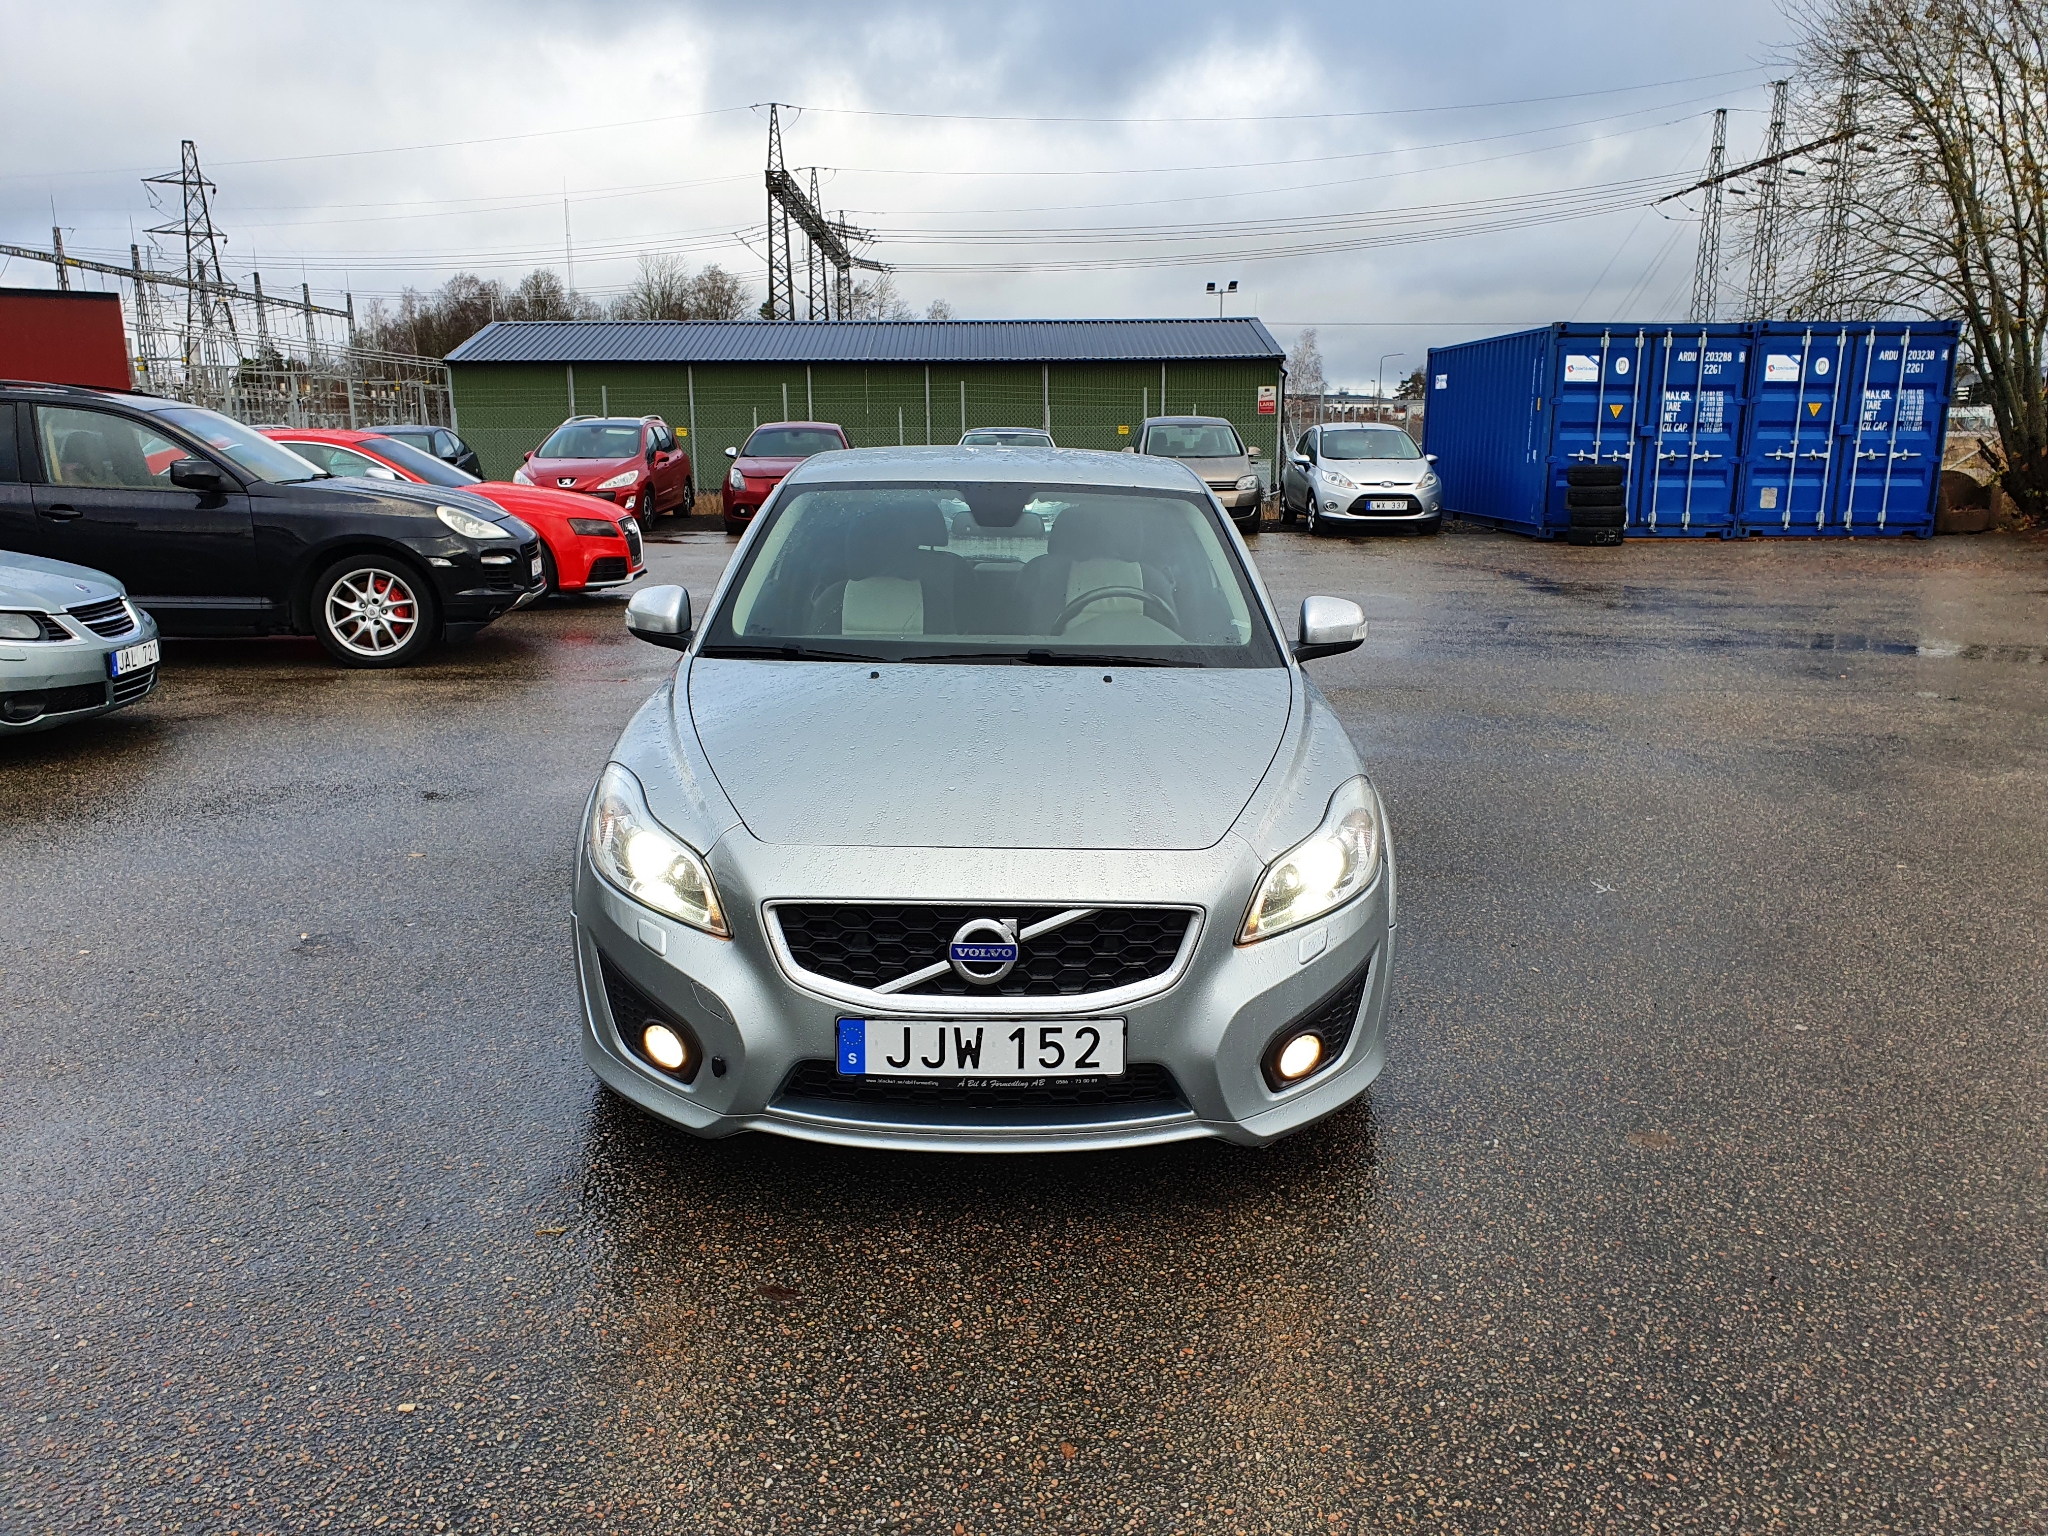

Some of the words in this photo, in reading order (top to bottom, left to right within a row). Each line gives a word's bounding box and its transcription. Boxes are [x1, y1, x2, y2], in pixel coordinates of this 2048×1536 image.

[1678, 351, 1697, 361] ARDU
[1704, 351, 1732, 362] 203288
[1878, 350, 1899, 360] ARDU
[1907, 350, 1935, 361] 203238
[1703, 364, 1721, 374] 22G1
[1905, 363, 1924, 373] 22G1
[1666, 402, 1681, 411] TARE
[1866, 400, 1882, 410] TARE
[1665, 412, 1677, 422] NET
[1864, 411, 1877, 421] NET
[119, 650, 137, 671] JAL
[143, 643, 158, 664] 721
[955, 947, 1013, 957] VOLVO
[886, 1026, 984, 1069] JJW
[1008, 1026, 1101, 1069] 152
[848, 1052, 857, 1065] S
[1031, 1079, 1046, 1087] AB
